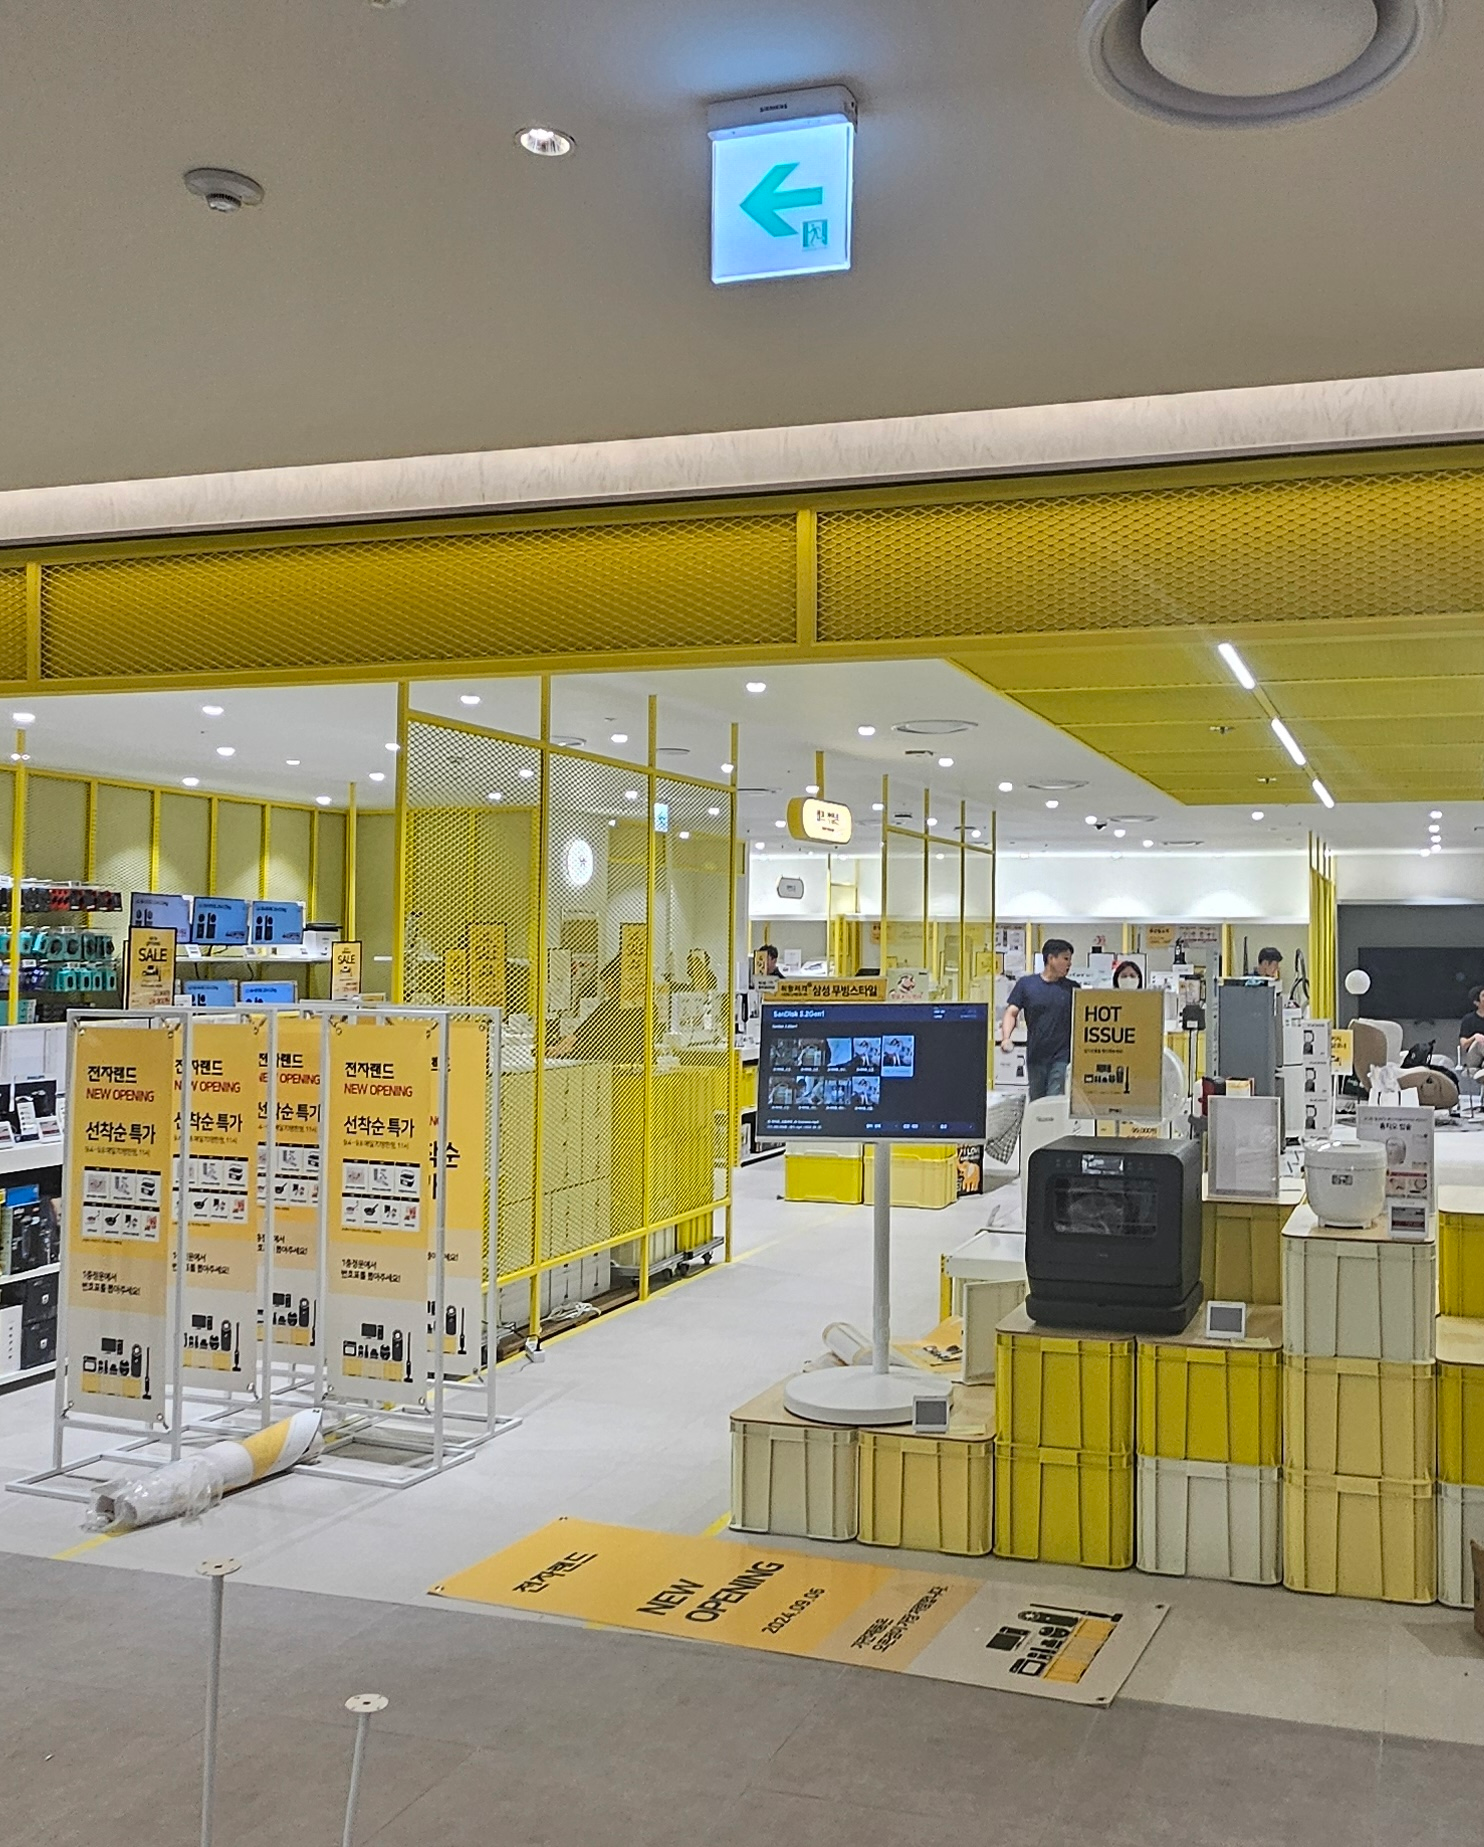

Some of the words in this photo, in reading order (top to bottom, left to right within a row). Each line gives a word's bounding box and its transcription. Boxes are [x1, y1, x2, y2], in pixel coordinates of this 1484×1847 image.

[139, 948, 167, 962] SALE
[338, 955, 355, 964] SALE
[813, 984, 830, 997] 삼성
[832, 984, 877, 997] 무빙스타일
[1085, 1005, 1122, 1022] HOT
[1084, 1026, 1136, 1044] ISSUE
[87, 1065, 138, 1084] 전자랜드
[279, 1073, 320, 1085] OPENING
[345, 1062, 394, 1080] 전자랜드
[86, 1088, 112, 1100] NEW
[112, 1089, 155, 1102] OPENING
[200, 1081, 241, 1093] OPENING
[344, 1083, 368, 1095] NEW
[370, 1084, 413, 1097] OPENING
[216, 1113, 243, 1133] 특가
[344, 1115, 385, 1137] 선착순
[387, 1117, 415, 1138] 특가
[85, 1121, 127, 1143] 선착순
[128, 1123, 156, 1145] 특가
[512, 1552, 598, 1593] 전자랜드
[636, 1578, 704, 1616] NEW
[685, 1561, 784, 1622] OPENING
[761, 1587, 826, 1634] 2024.09.06
